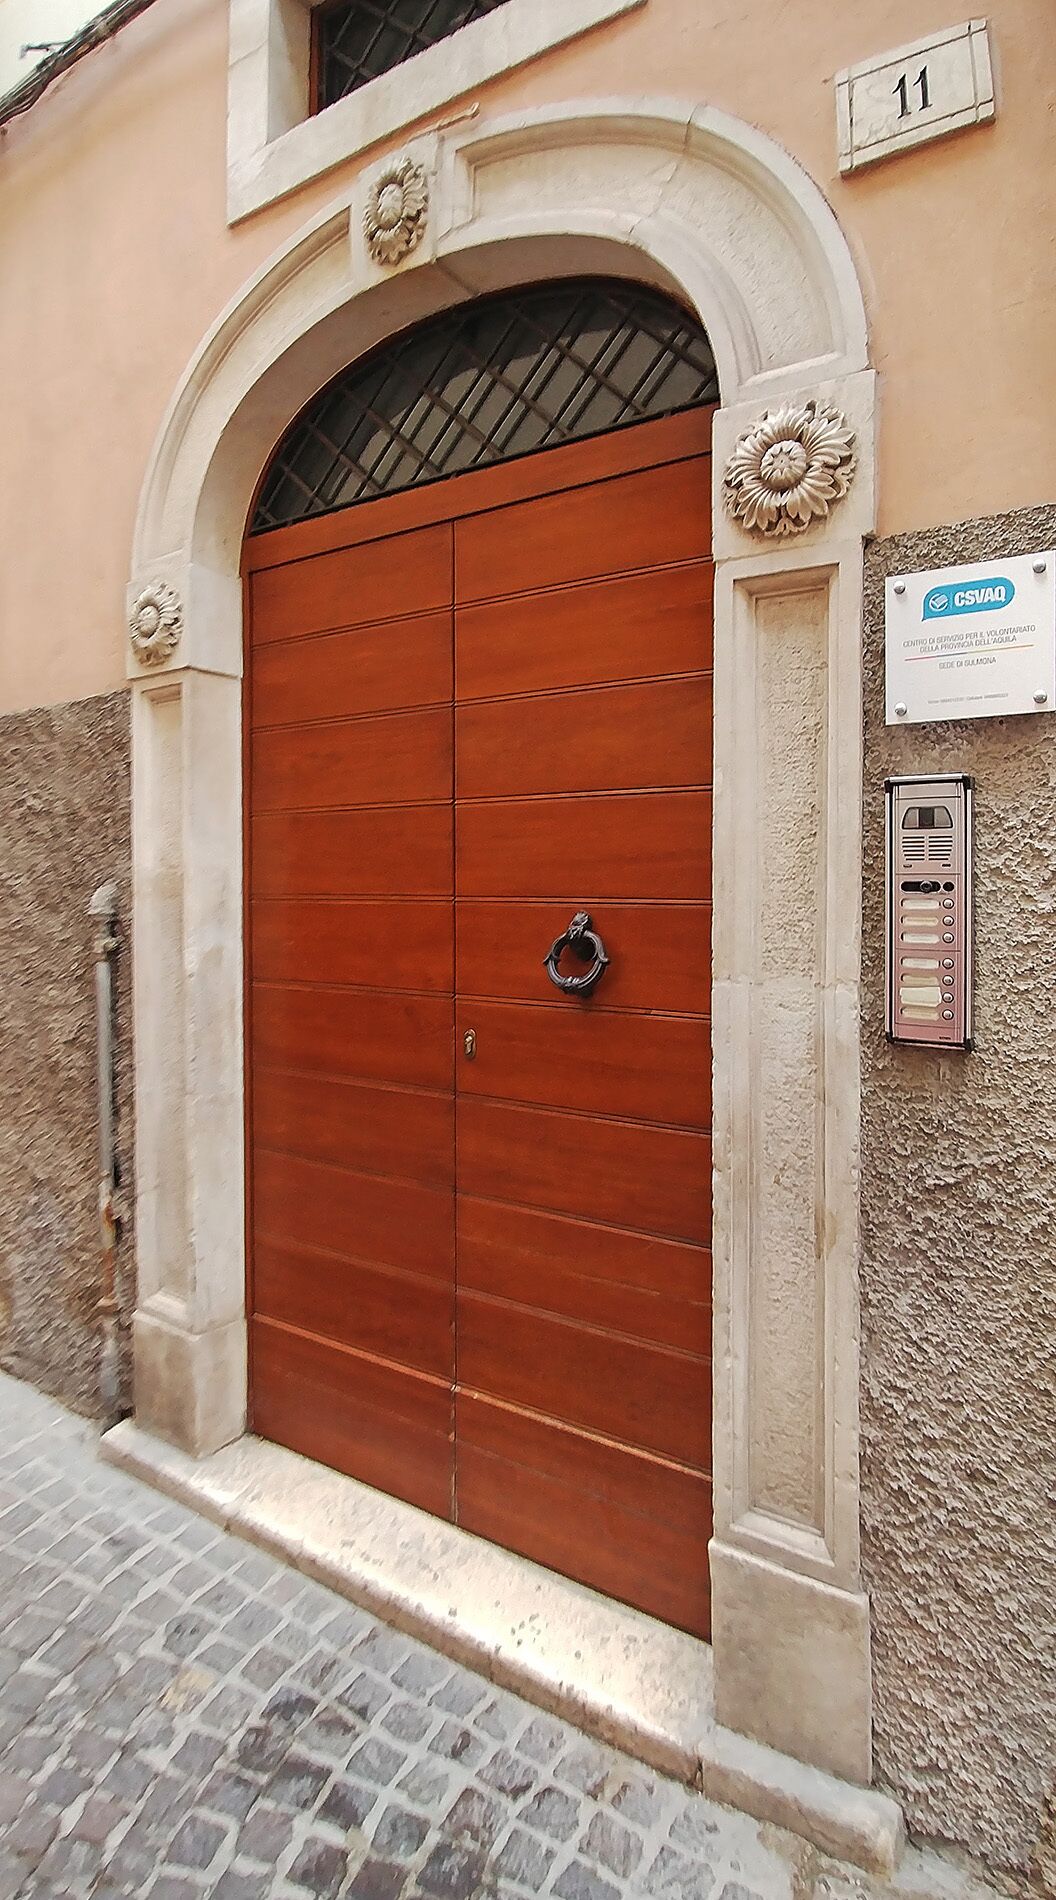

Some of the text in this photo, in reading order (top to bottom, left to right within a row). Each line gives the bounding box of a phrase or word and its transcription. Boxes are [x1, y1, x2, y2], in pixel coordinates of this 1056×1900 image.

[891, 65, 933, 119] 11
[954, 585, 1006, 607] CSVAQ
[902, 625, 1036, 648] CENTRO DI SERVIZIO PER IL VOLONTARIATO
[920, 635, 1017, 653] DELLA PROVINCIA DELL'AQUILA
[956, 660, 963, 668] DI
[964, 657, 997, 667] SULMONA
